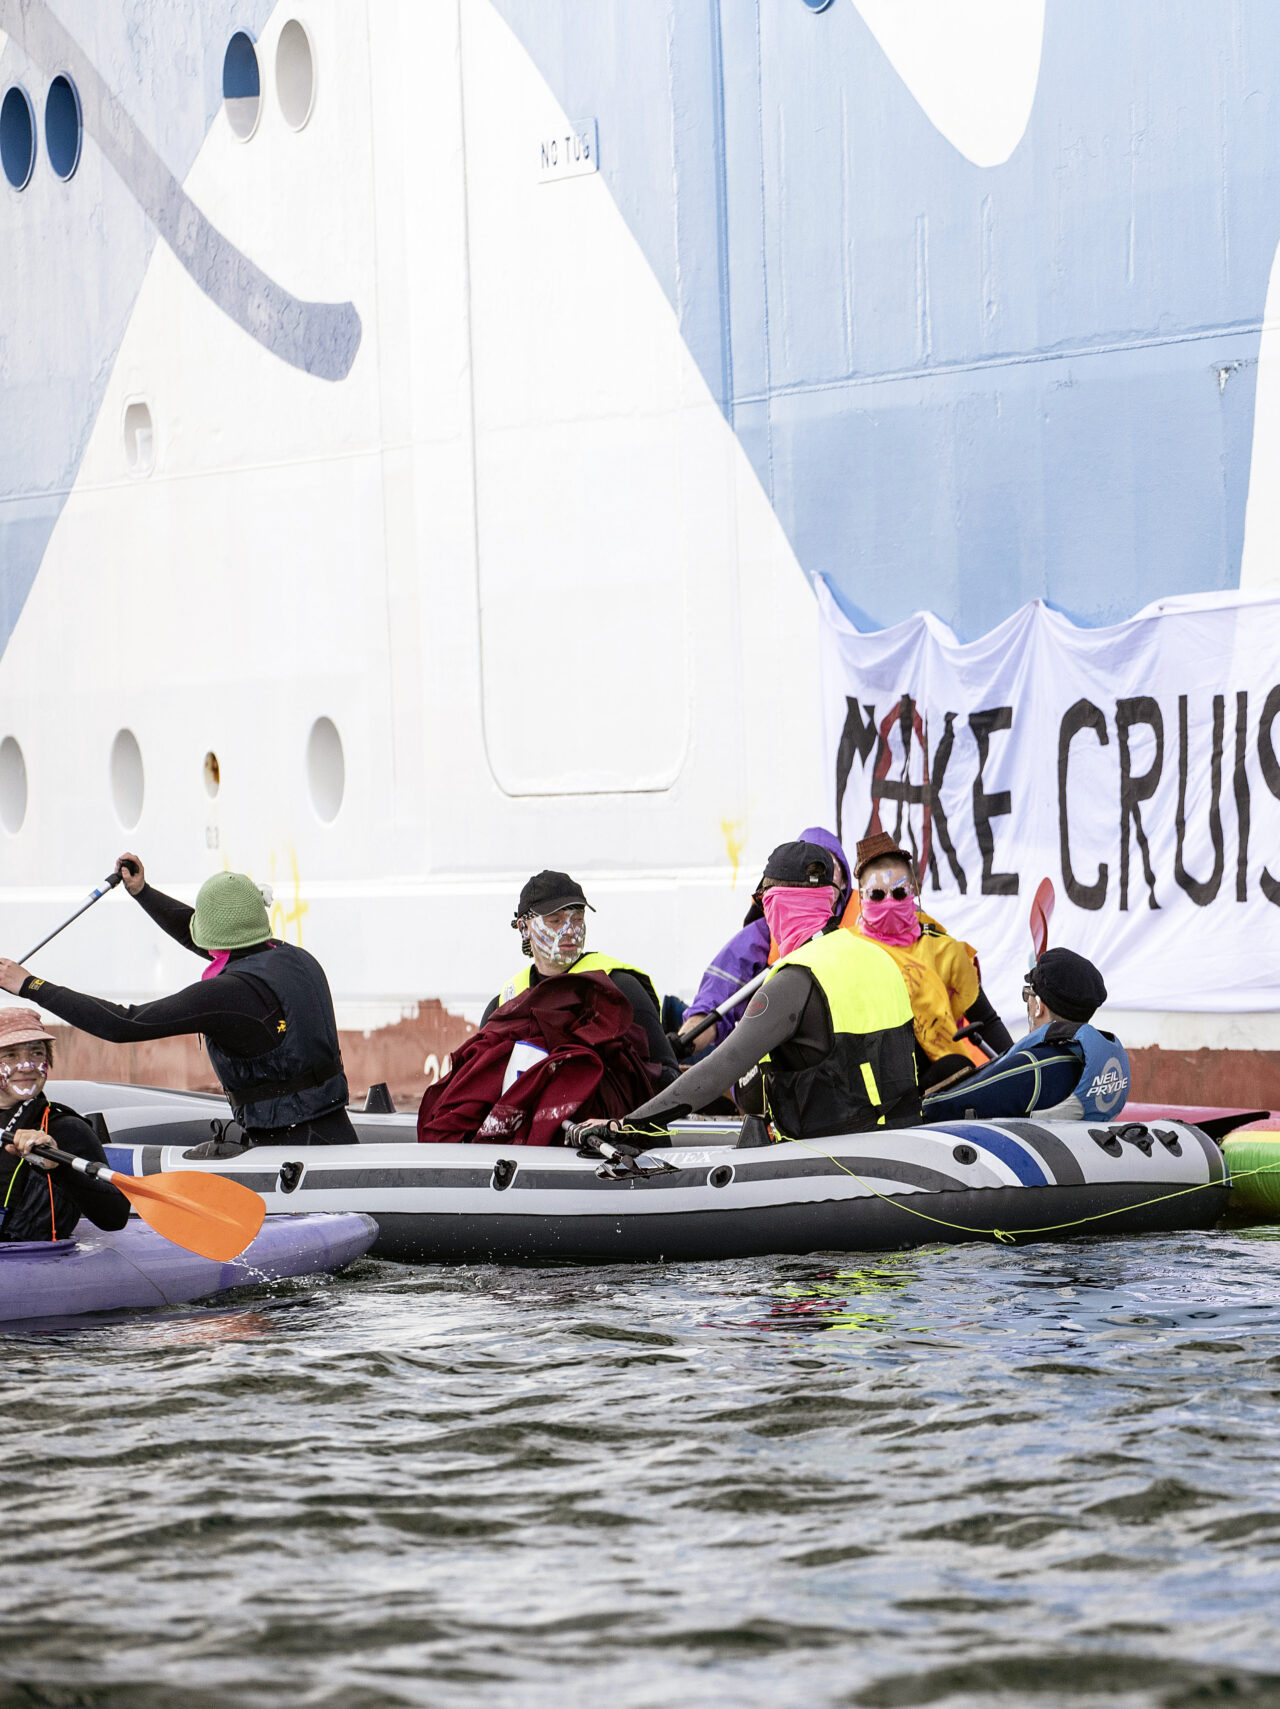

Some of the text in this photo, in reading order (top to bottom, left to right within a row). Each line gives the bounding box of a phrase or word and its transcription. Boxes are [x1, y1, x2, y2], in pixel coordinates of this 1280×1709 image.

[541, 133, 589, 168] NO TUG
[836, 693, 1019, 895] MAKE
[1086, 1077, 1128, 1098] PRYDE
[1092, 1071, 1119, 1087] NEIL
